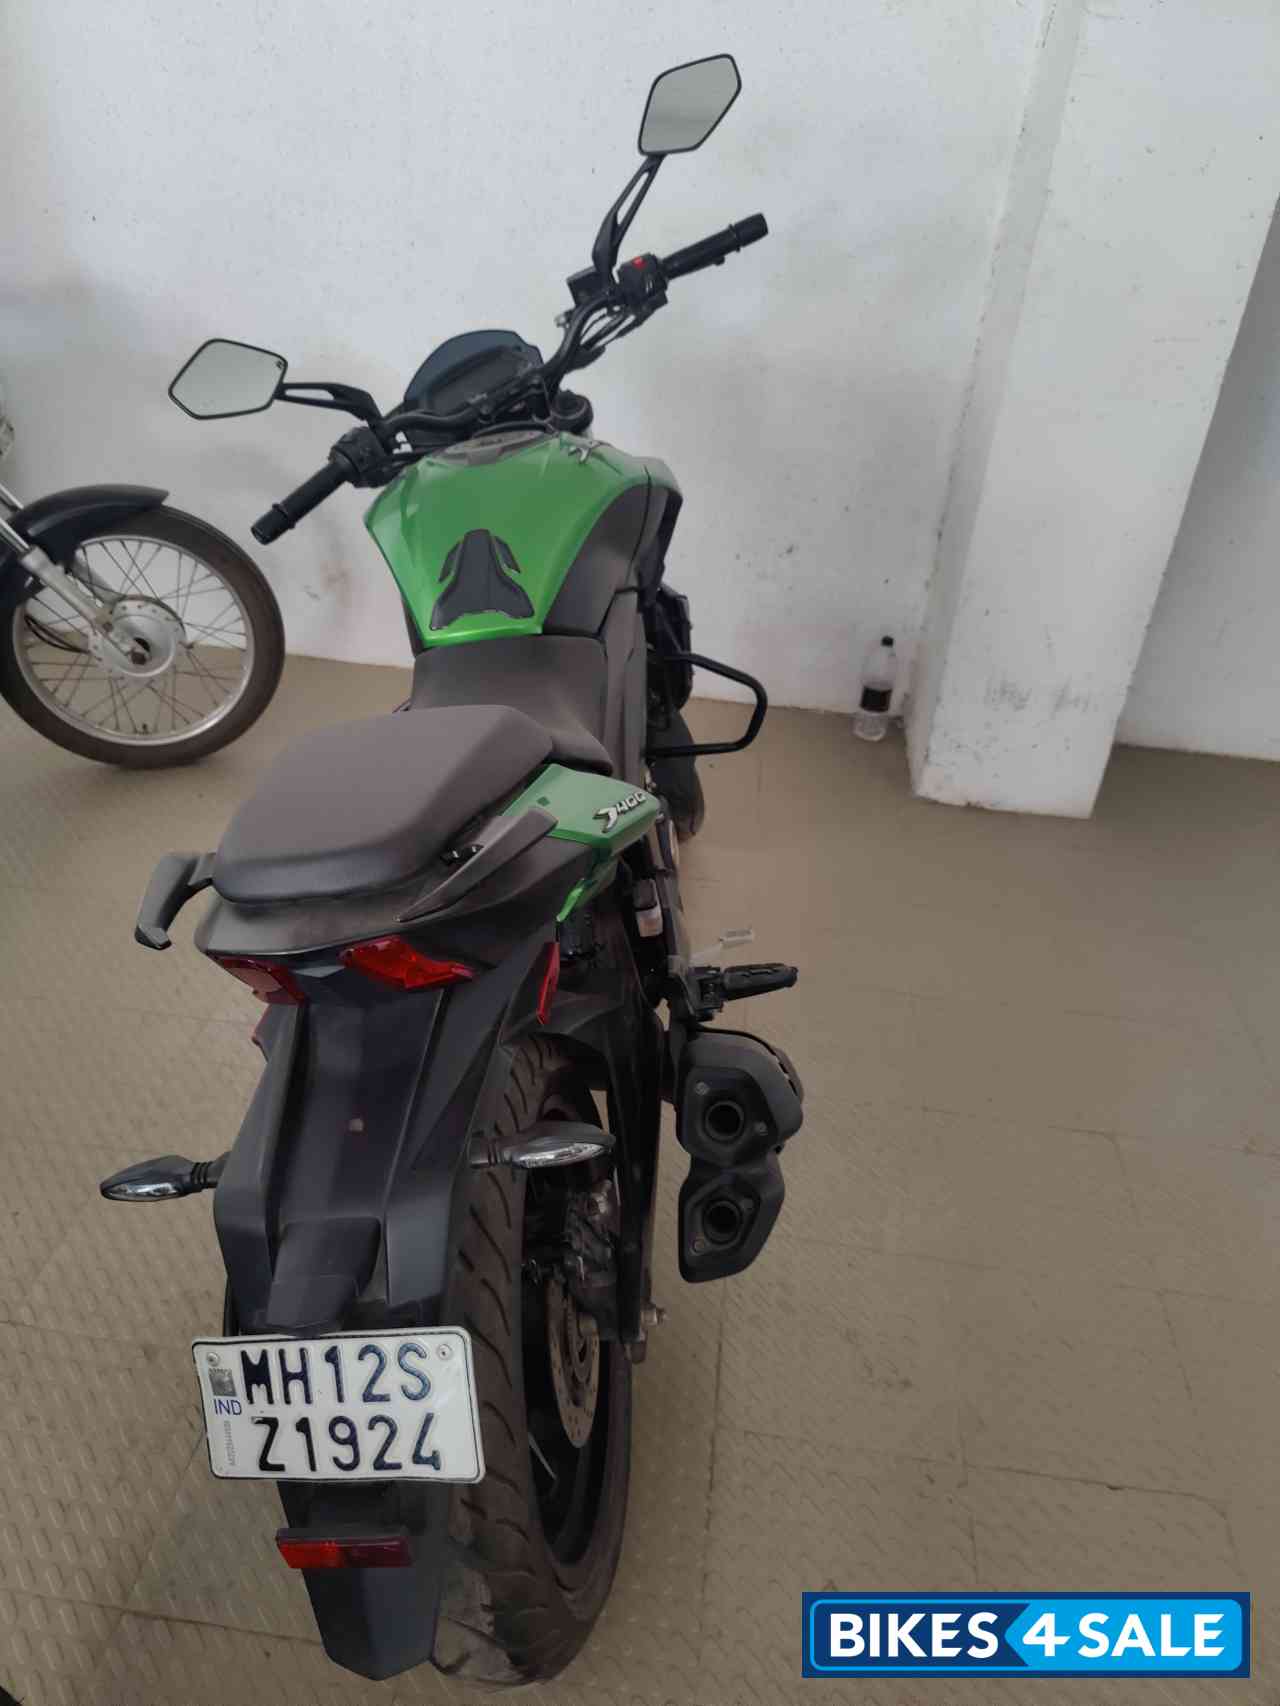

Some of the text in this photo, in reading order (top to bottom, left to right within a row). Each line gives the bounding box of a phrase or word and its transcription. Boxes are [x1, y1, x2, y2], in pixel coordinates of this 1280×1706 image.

[241, 1342, 432, 1405] MH12S
[213, 1398, 243, 1416] IND
[251, 1412, 442, 1472] Z1924
